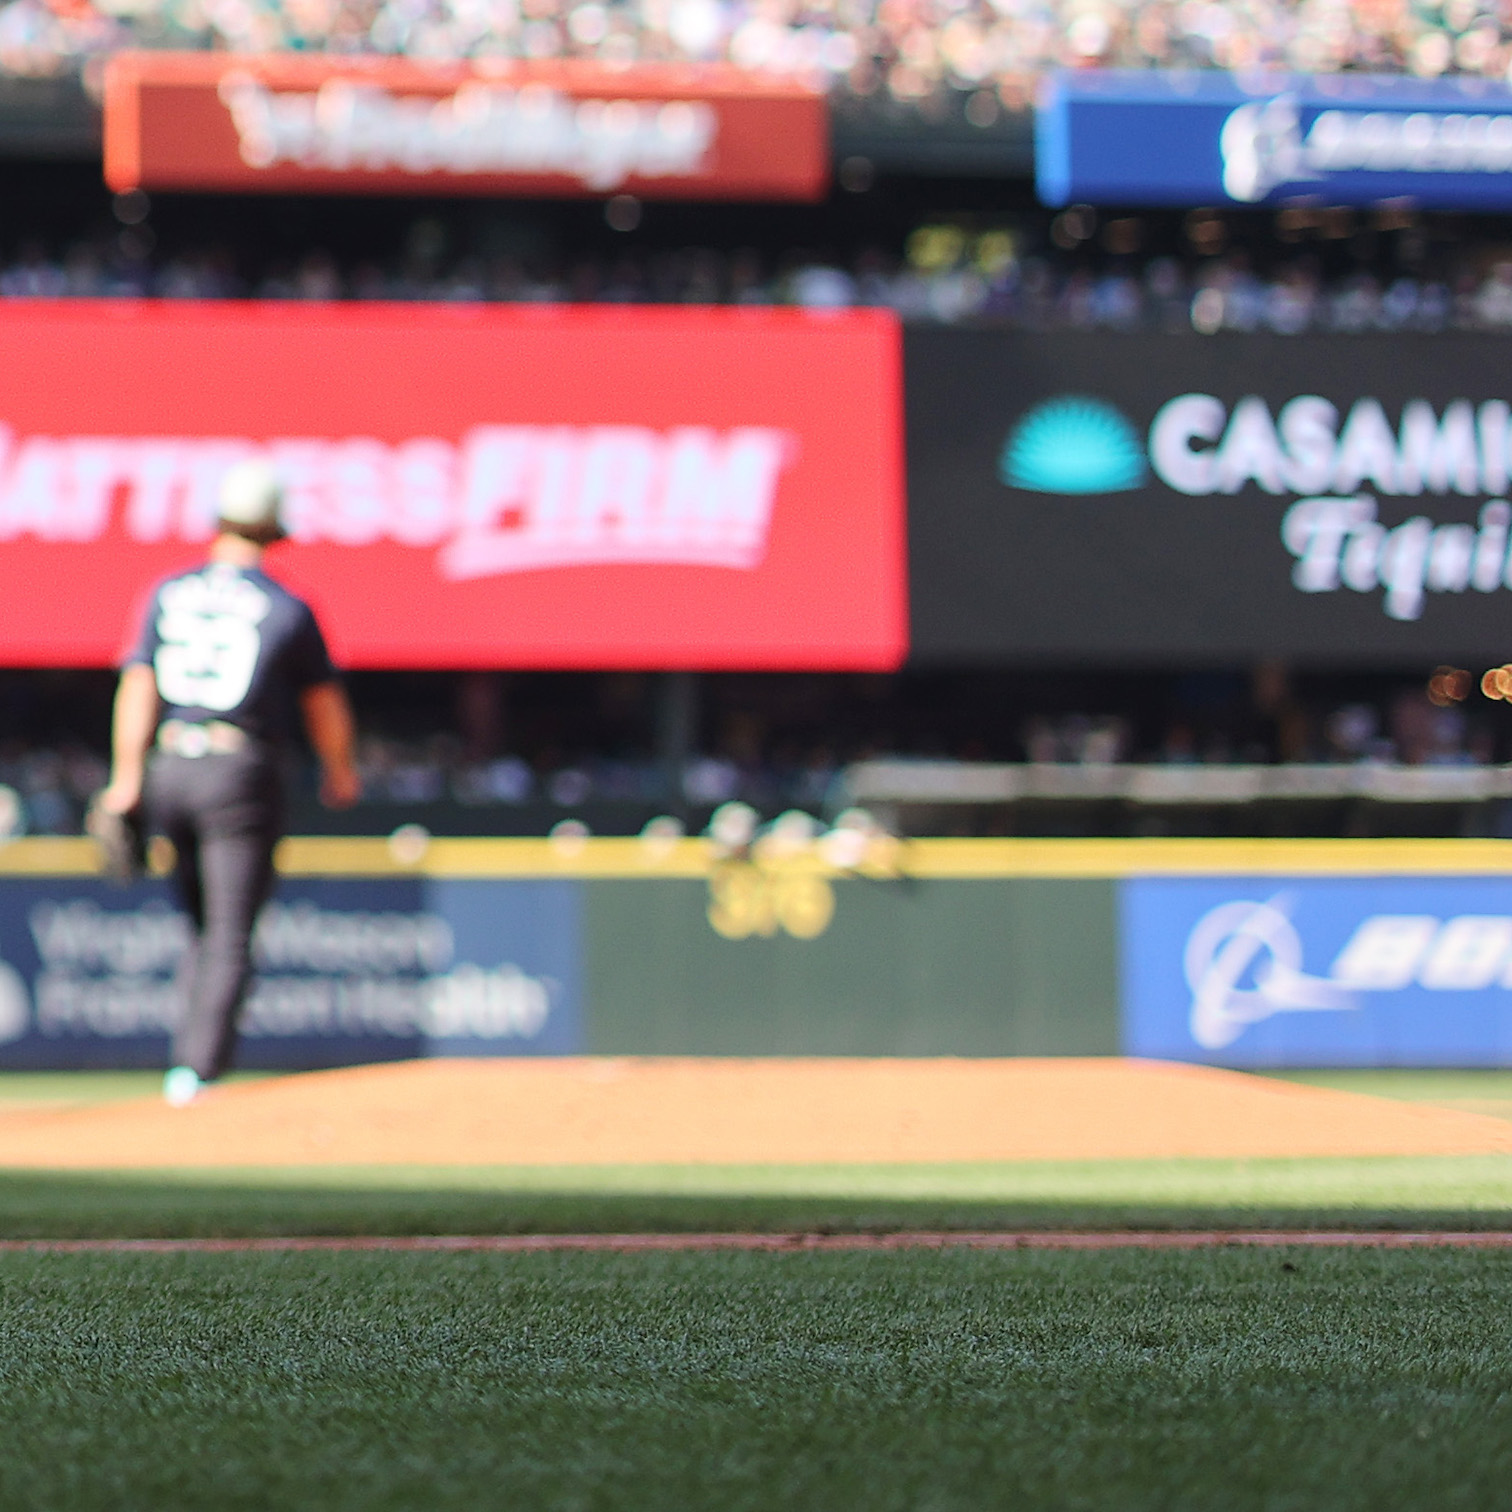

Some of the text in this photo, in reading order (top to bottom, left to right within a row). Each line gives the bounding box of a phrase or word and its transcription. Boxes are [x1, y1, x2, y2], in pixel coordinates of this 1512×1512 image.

[1148, 393, 1512, 497] CASAMI
[1280, 491, 1512, 621] Tequi
[1328, 912, 1512, 991] BO
